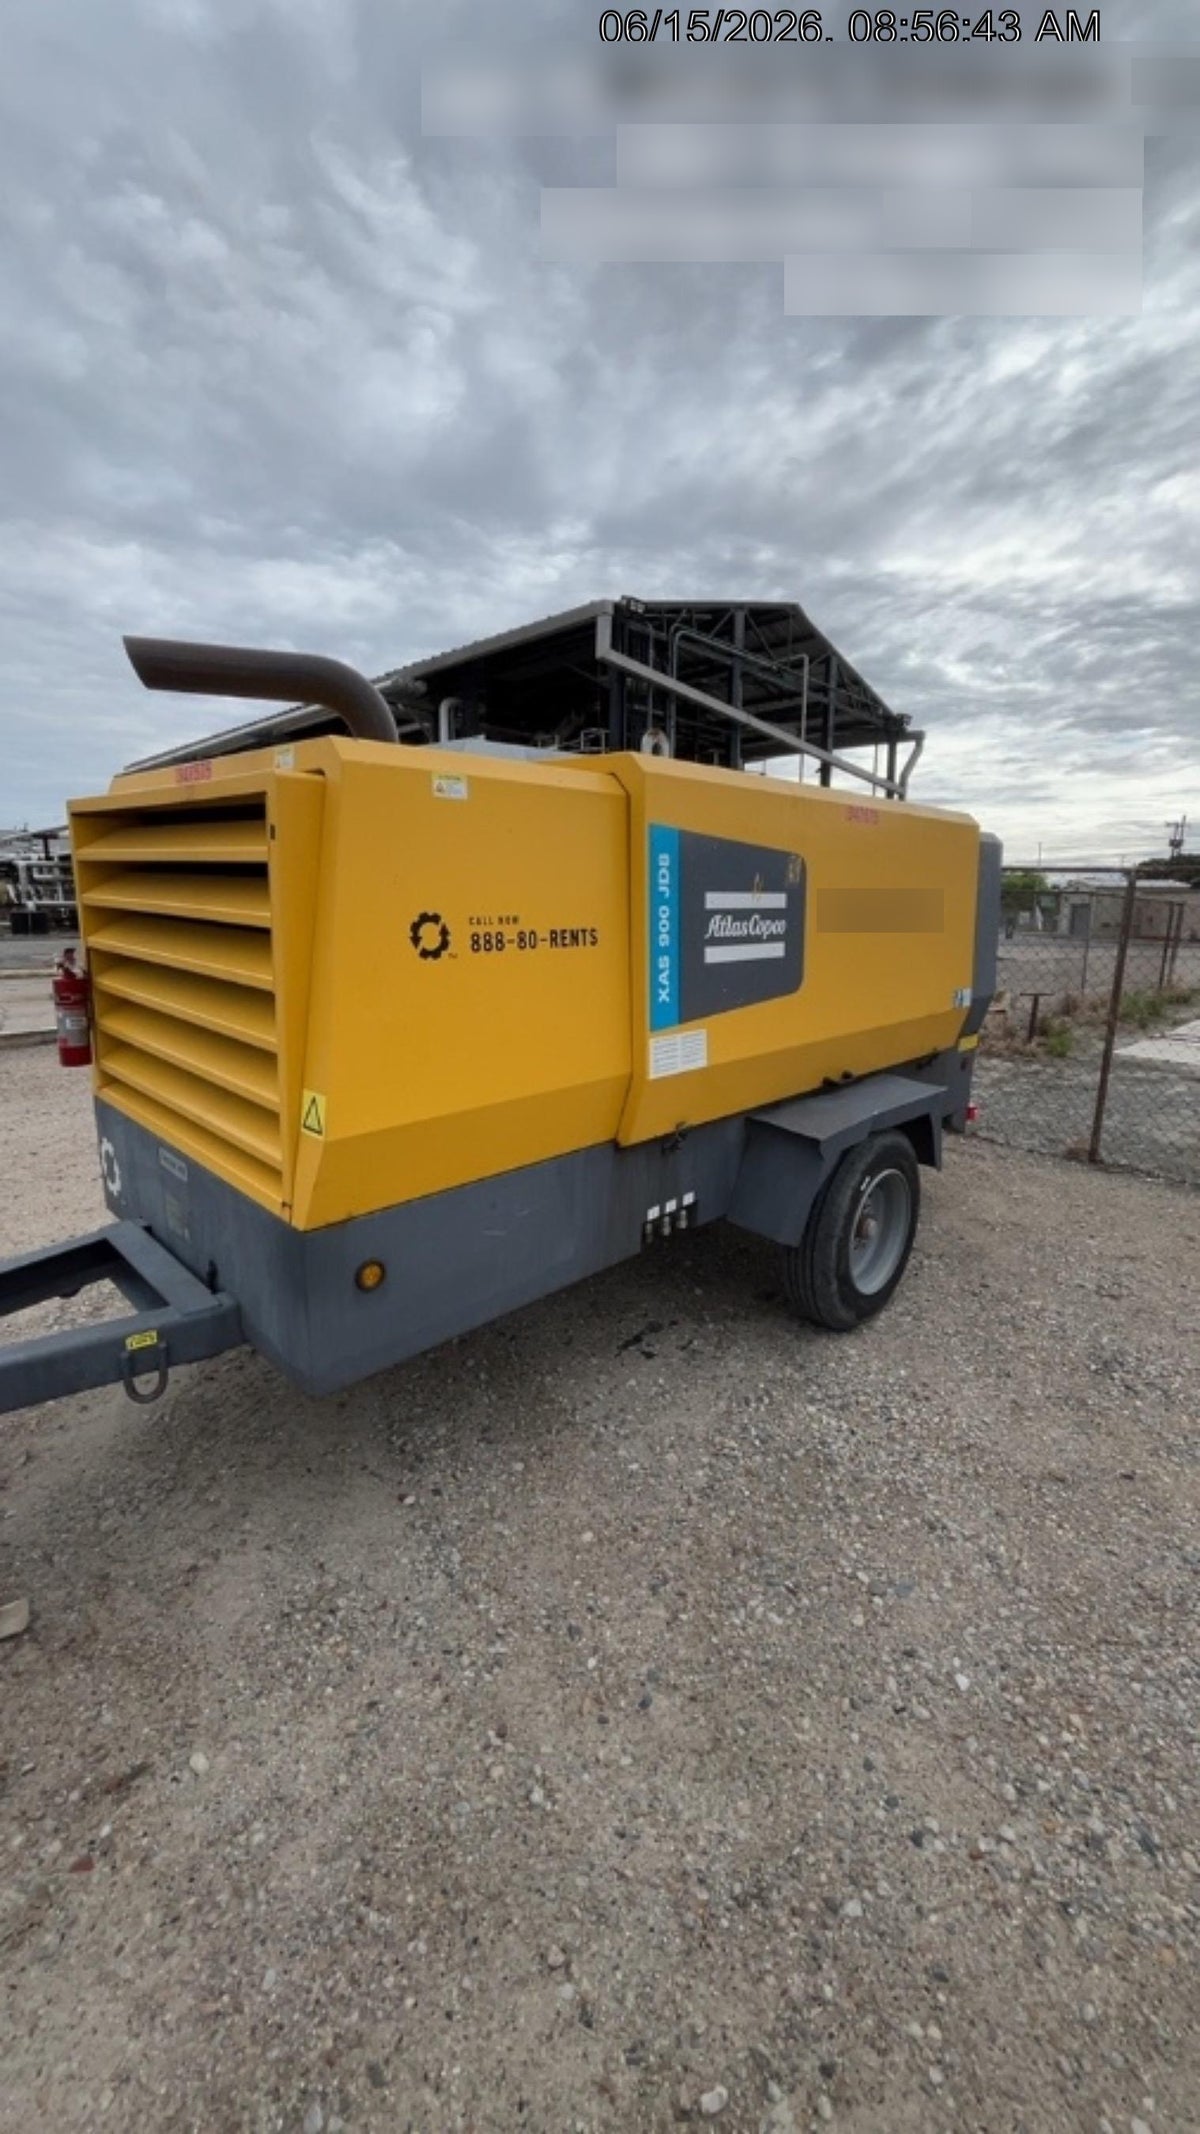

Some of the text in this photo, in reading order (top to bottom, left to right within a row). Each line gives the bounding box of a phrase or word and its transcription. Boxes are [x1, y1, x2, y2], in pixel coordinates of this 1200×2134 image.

[468, 915, 519, 926] CALL NOW
[658, 905, 671, 947] 900
[470, 928, 599, 953] 888-80-RENTS
[658, 955, 671, 1003] XAS
